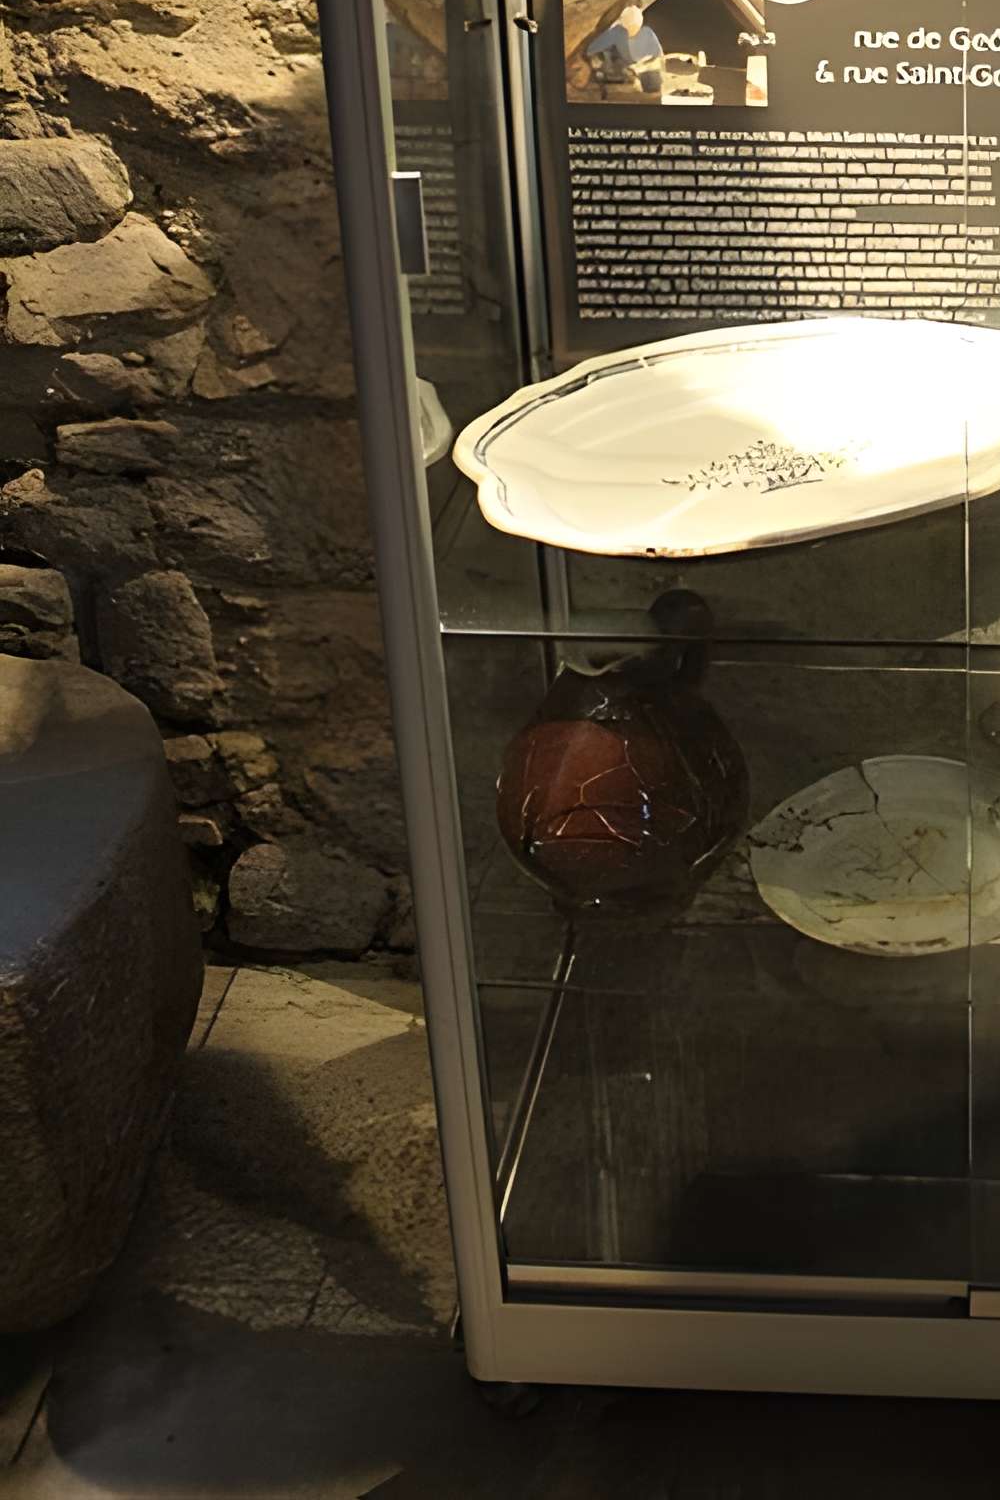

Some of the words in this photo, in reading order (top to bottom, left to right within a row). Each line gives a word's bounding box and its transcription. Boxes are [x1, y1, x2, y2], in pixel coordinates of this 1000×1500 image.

[853, 30, 900, 49] rue
[906, 27, 942, 50] de
[815, 59, 836, 84] &
[843, 66, 889, 85] rue
